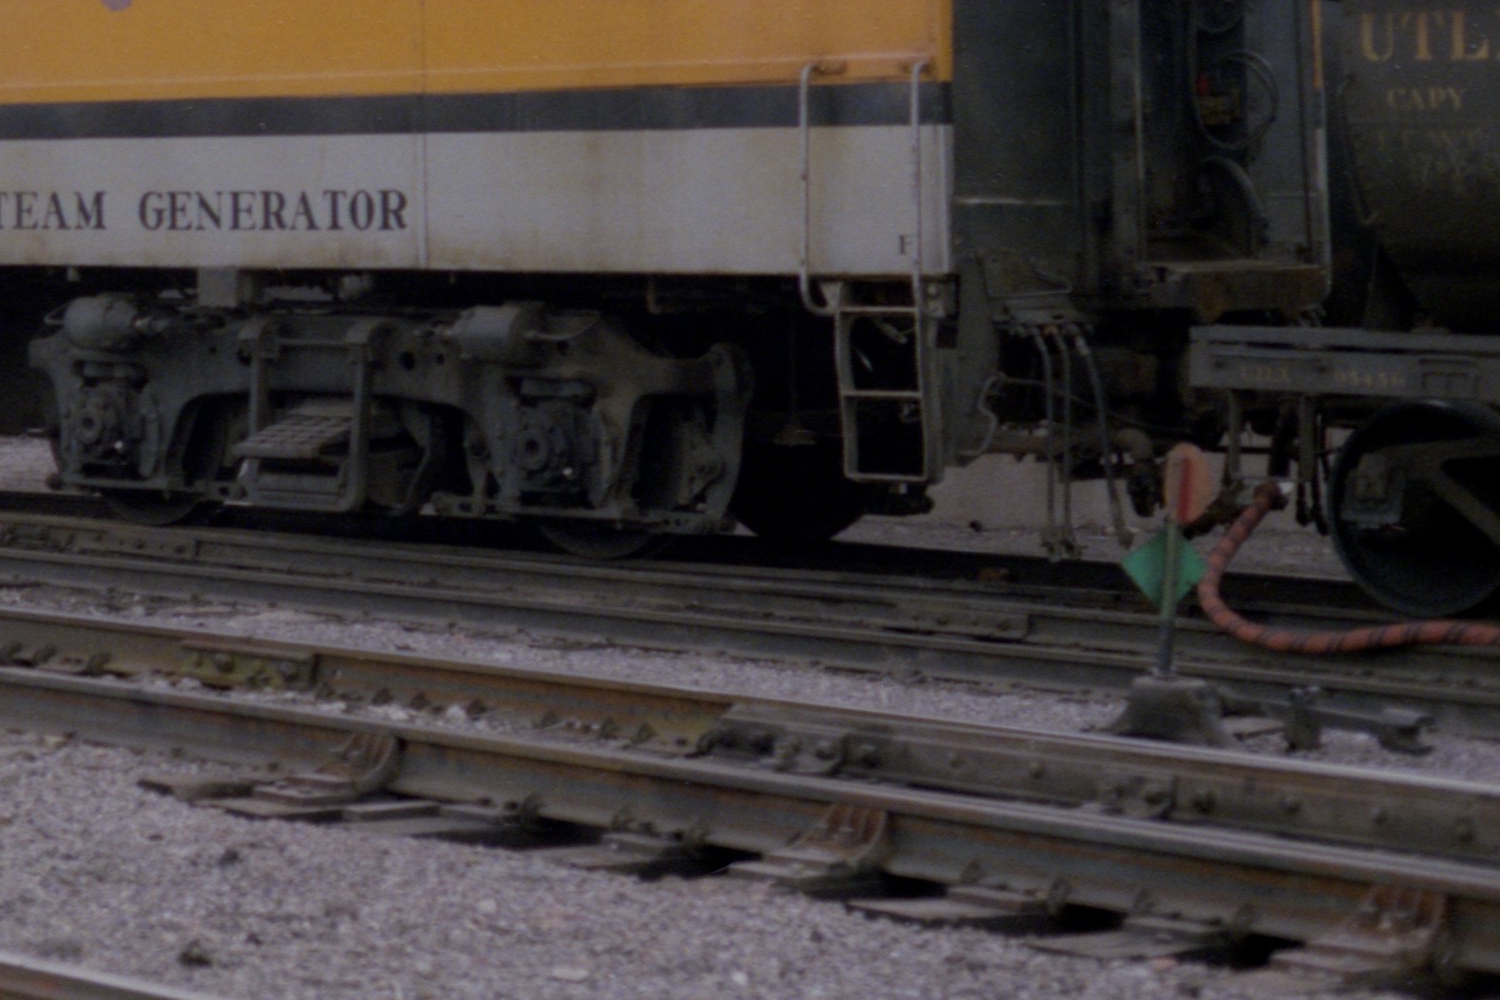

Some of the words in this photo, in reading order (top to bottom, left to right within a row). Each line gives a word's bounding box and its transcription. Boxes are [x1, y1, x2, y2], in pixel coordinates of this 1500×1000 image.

[1359, 9, 1500, 62] UTL
[1385, 86, 1466, 110] CAPY
[138, 188, 409, 232] GENERATOR
